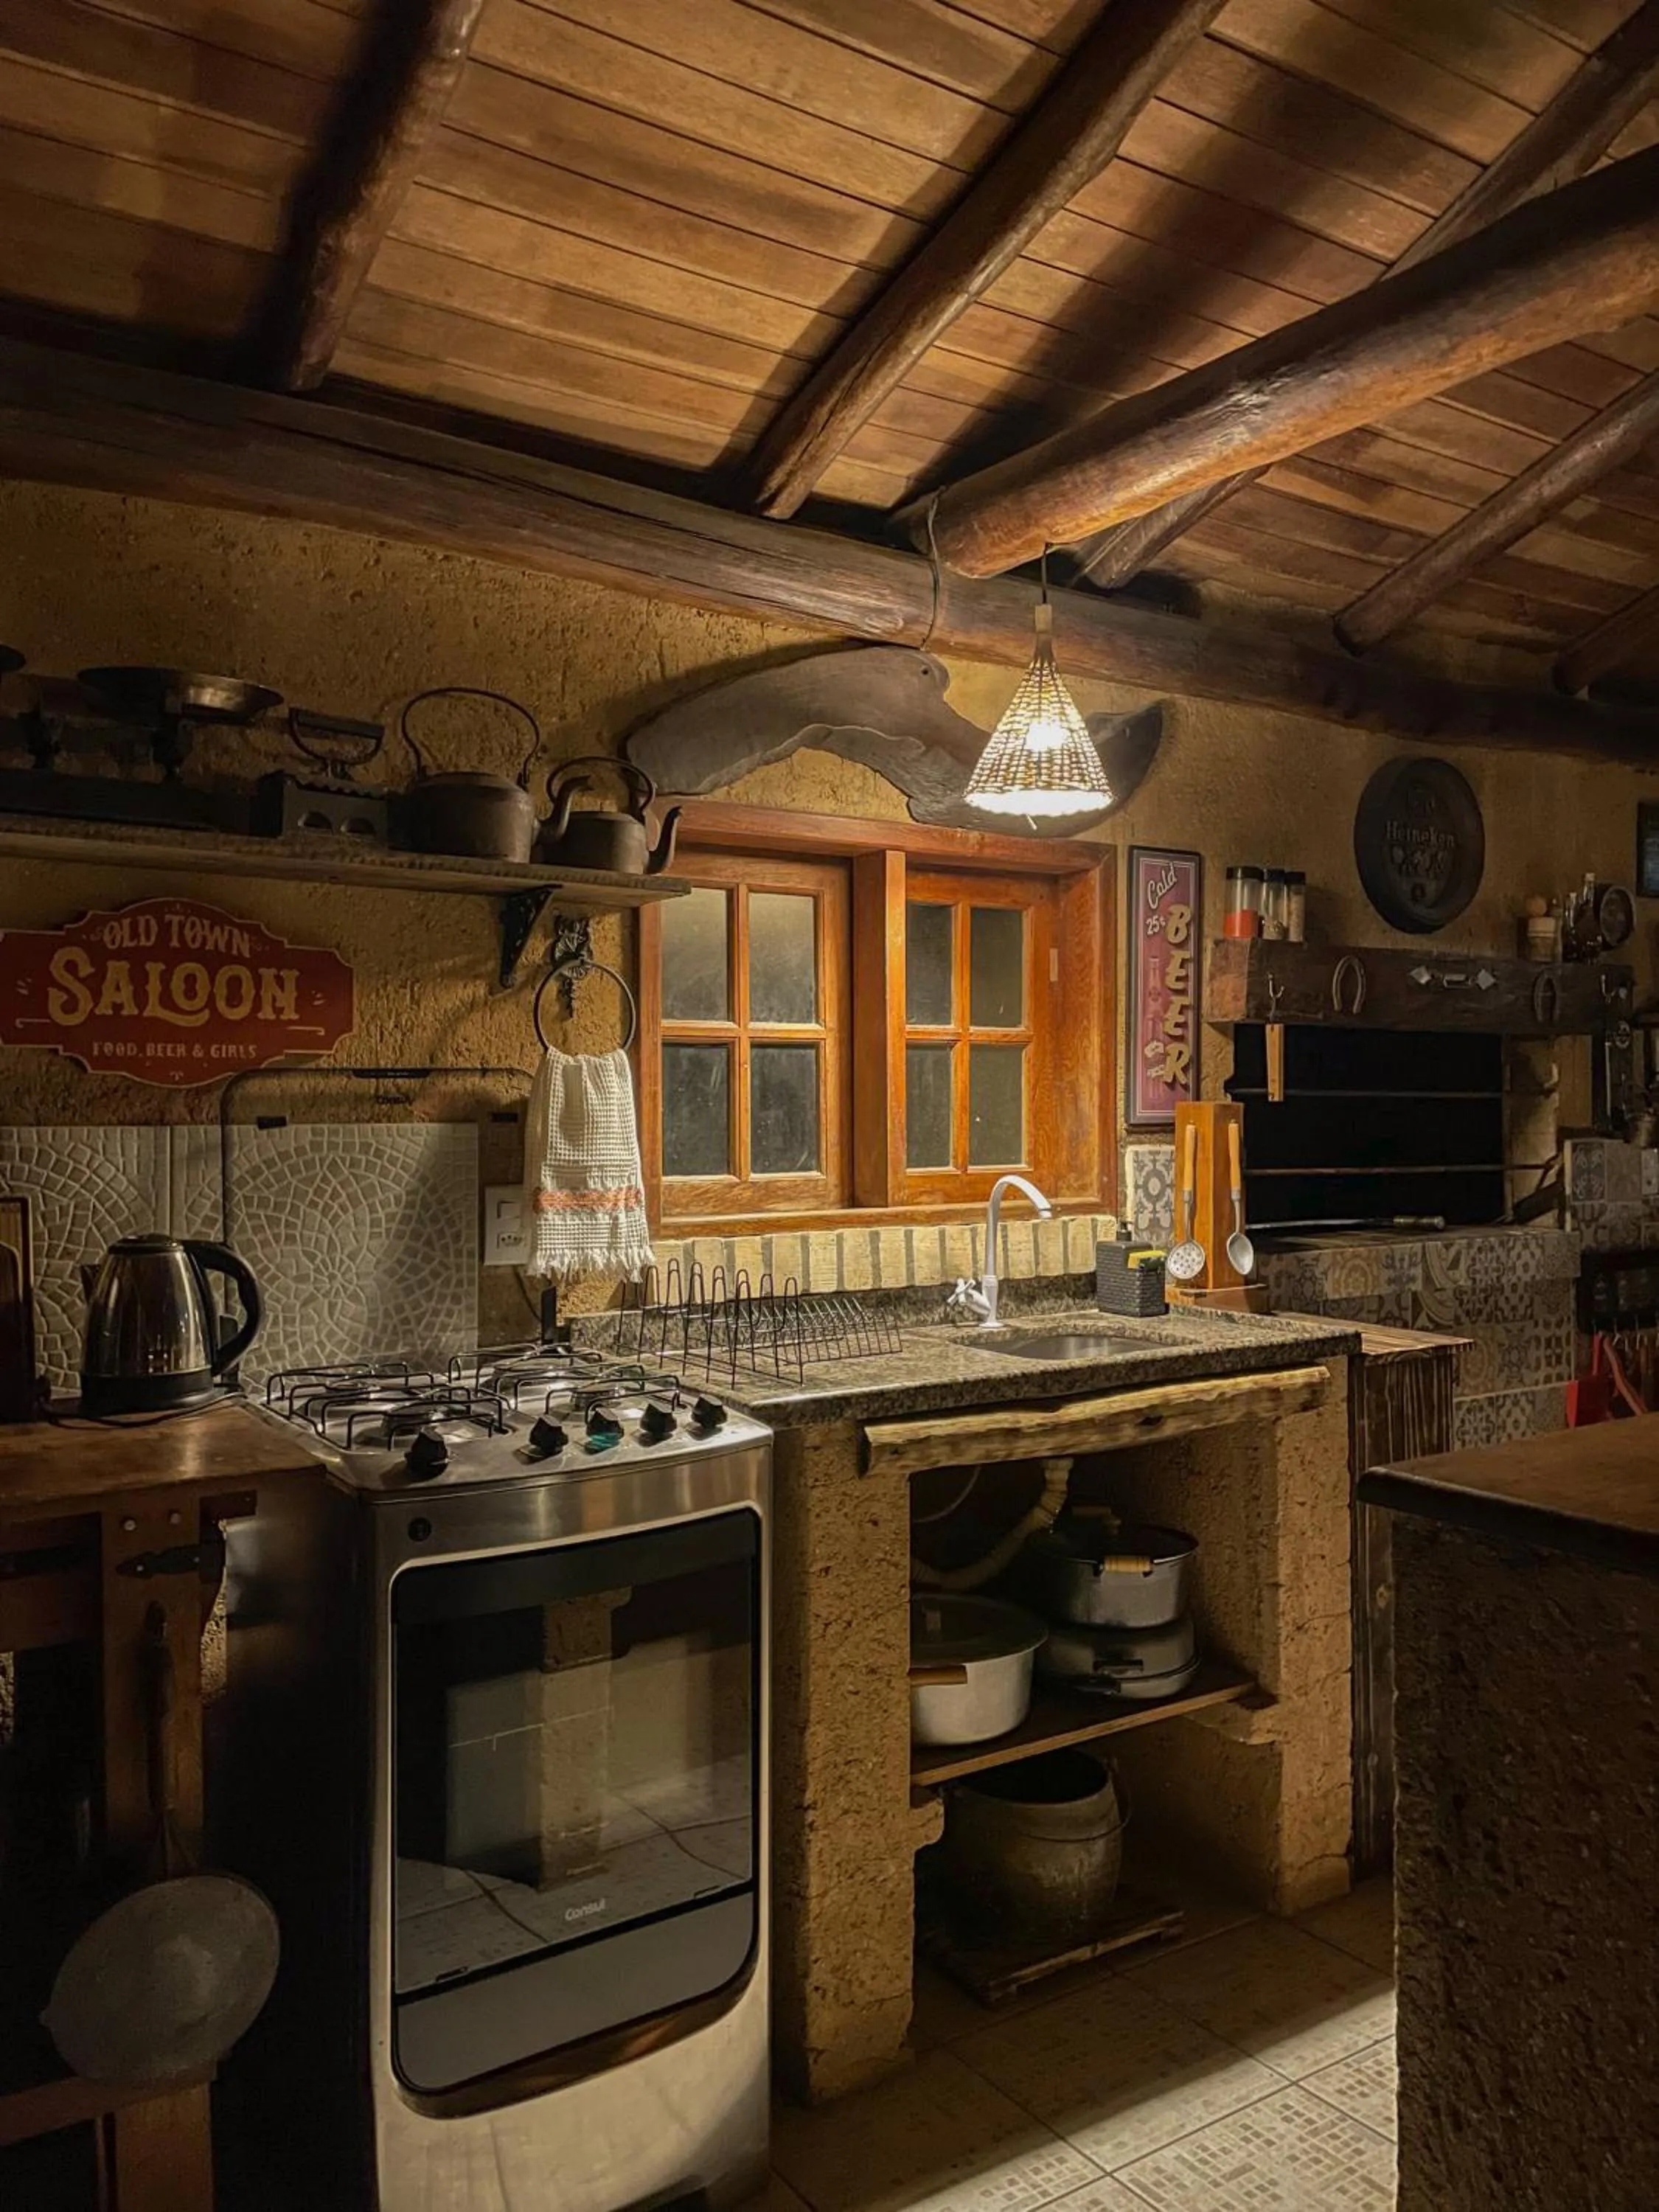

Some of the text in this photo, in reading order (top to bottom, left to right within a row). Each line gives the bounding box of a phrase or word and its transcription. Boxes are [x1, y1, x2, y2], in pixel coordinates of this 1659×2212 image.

[1385, 820, 1455, 848] Heineken
[1147, 862, 1177, 909] Cold
[102, 914, 250, 958] OLD TOWN
[47, 946, 301, 1027] SALOON
[1163, 904, 1192, 1084] BEER
[147, 1043, 186, 1058] BEER
[192, 1044, 204, 1058] &
[210, 1044, 257, 1059] GIRLS
